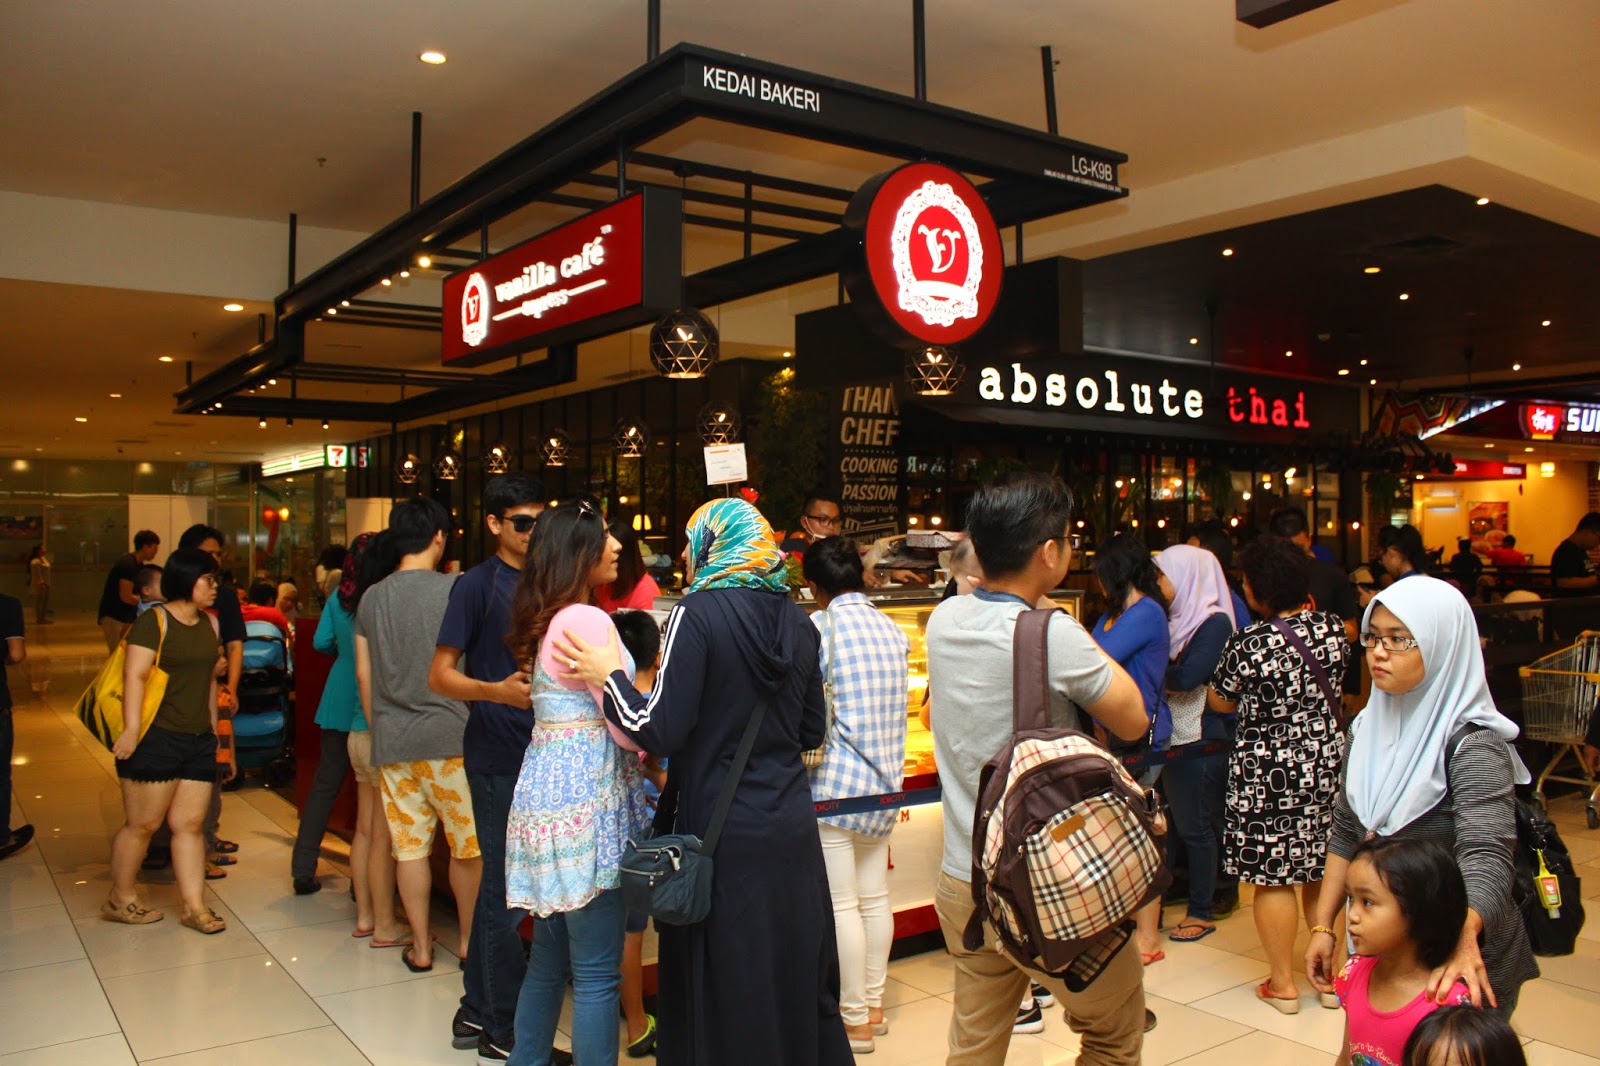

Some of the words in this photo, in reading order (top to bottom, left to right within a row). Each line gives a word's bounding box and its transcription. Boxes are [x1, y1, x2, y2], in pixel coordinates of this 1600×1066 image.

[703, 65, 755, 98] KEDAI
[760, 78, 820, 112] BAKERI
[1071, 154, 1113, 182] LG-K9B
[494, 261, 557, 302] vanilla
[560, 236, 604, 278] café
[842, 385, 892, 414] THAI
[978, 363, 1204, 418] absolute
[1226, 387, 1311, 428] thai
[840, 416, 899, 446] CHEF
[1566, 407, 1600, 433] SU
[840, 456, 898, 475] COOKING
[842, 484, 898, 500] PASSION
